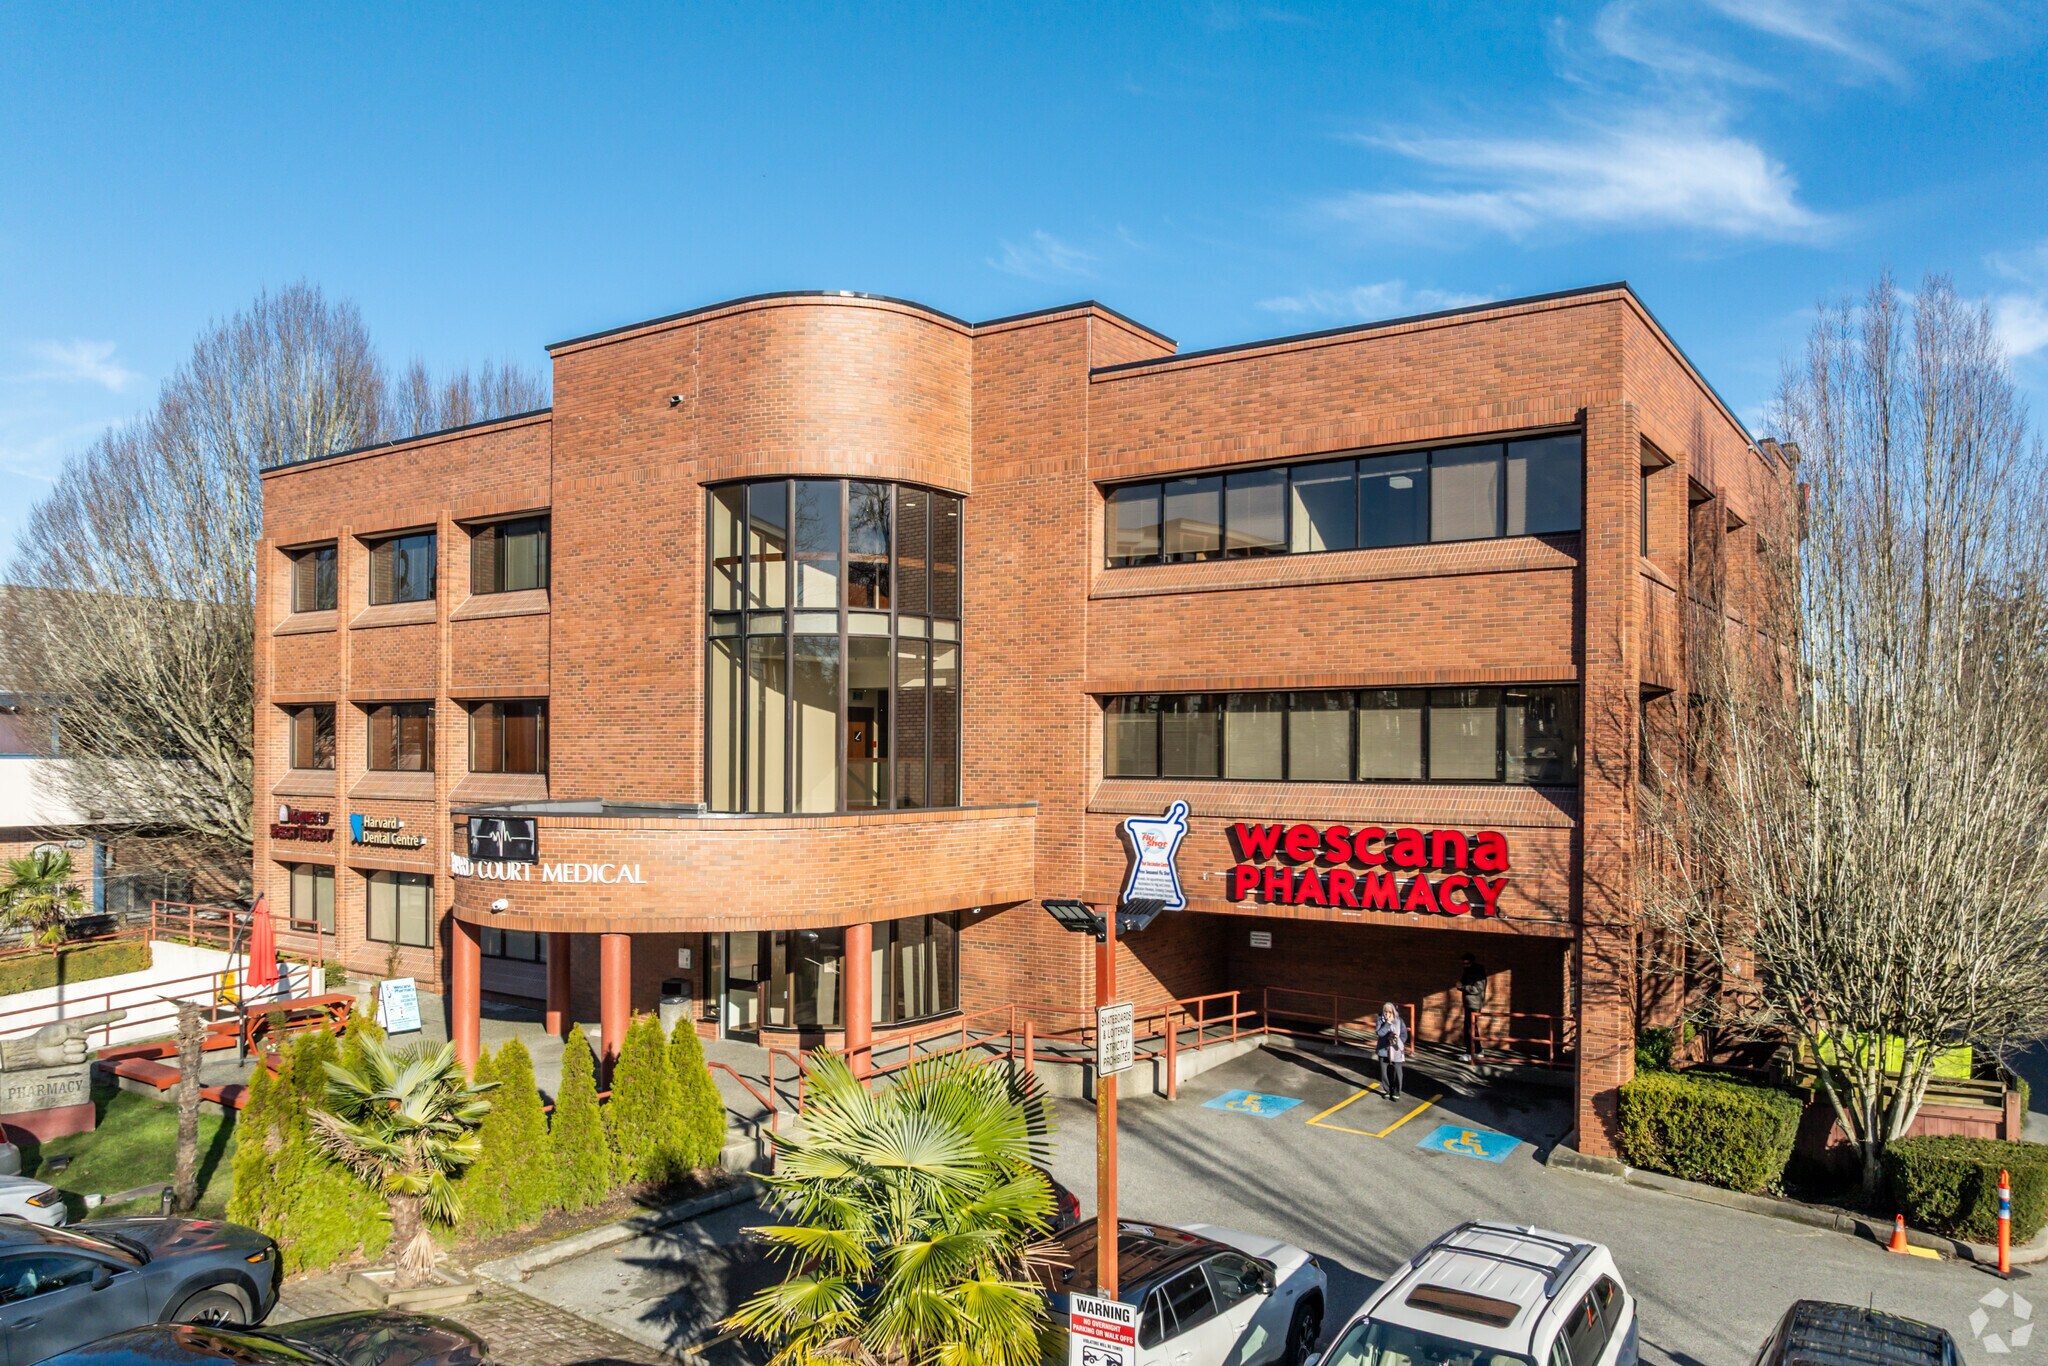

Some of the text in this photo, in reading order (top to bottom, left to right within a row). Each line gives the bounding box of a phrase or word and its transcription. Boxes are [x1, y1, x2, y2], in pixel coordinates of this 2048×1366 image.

[363, 815, 397, 829] Harvard
[363, 831, 419, 846] Dental Centre
[1234, 822, 1511, 872] wescana
[477, 860, 533, 882] COURT
[542, 862, 647, 884] MEDICAL
[1234, 864, 1510, 916] PHARMACY
[1101, 1010, 1132, 1027] SKATEBOARDS
[1107, 1024, 1130, 1039] LOITERING
[1105, 1039, 1128, 1054] STRICTLY
[1103, 1051, 1131, 1068] PROHIBITED
[8, 1079, 83, 1100] PHARMACY
[1076, 1298, 1131, 1323] WARNING
[1083, 1318, 1121, 1332] NO OVERNIGHT
[1073, 1324, 1134, 1344] PARKING OR WALK OFFS
